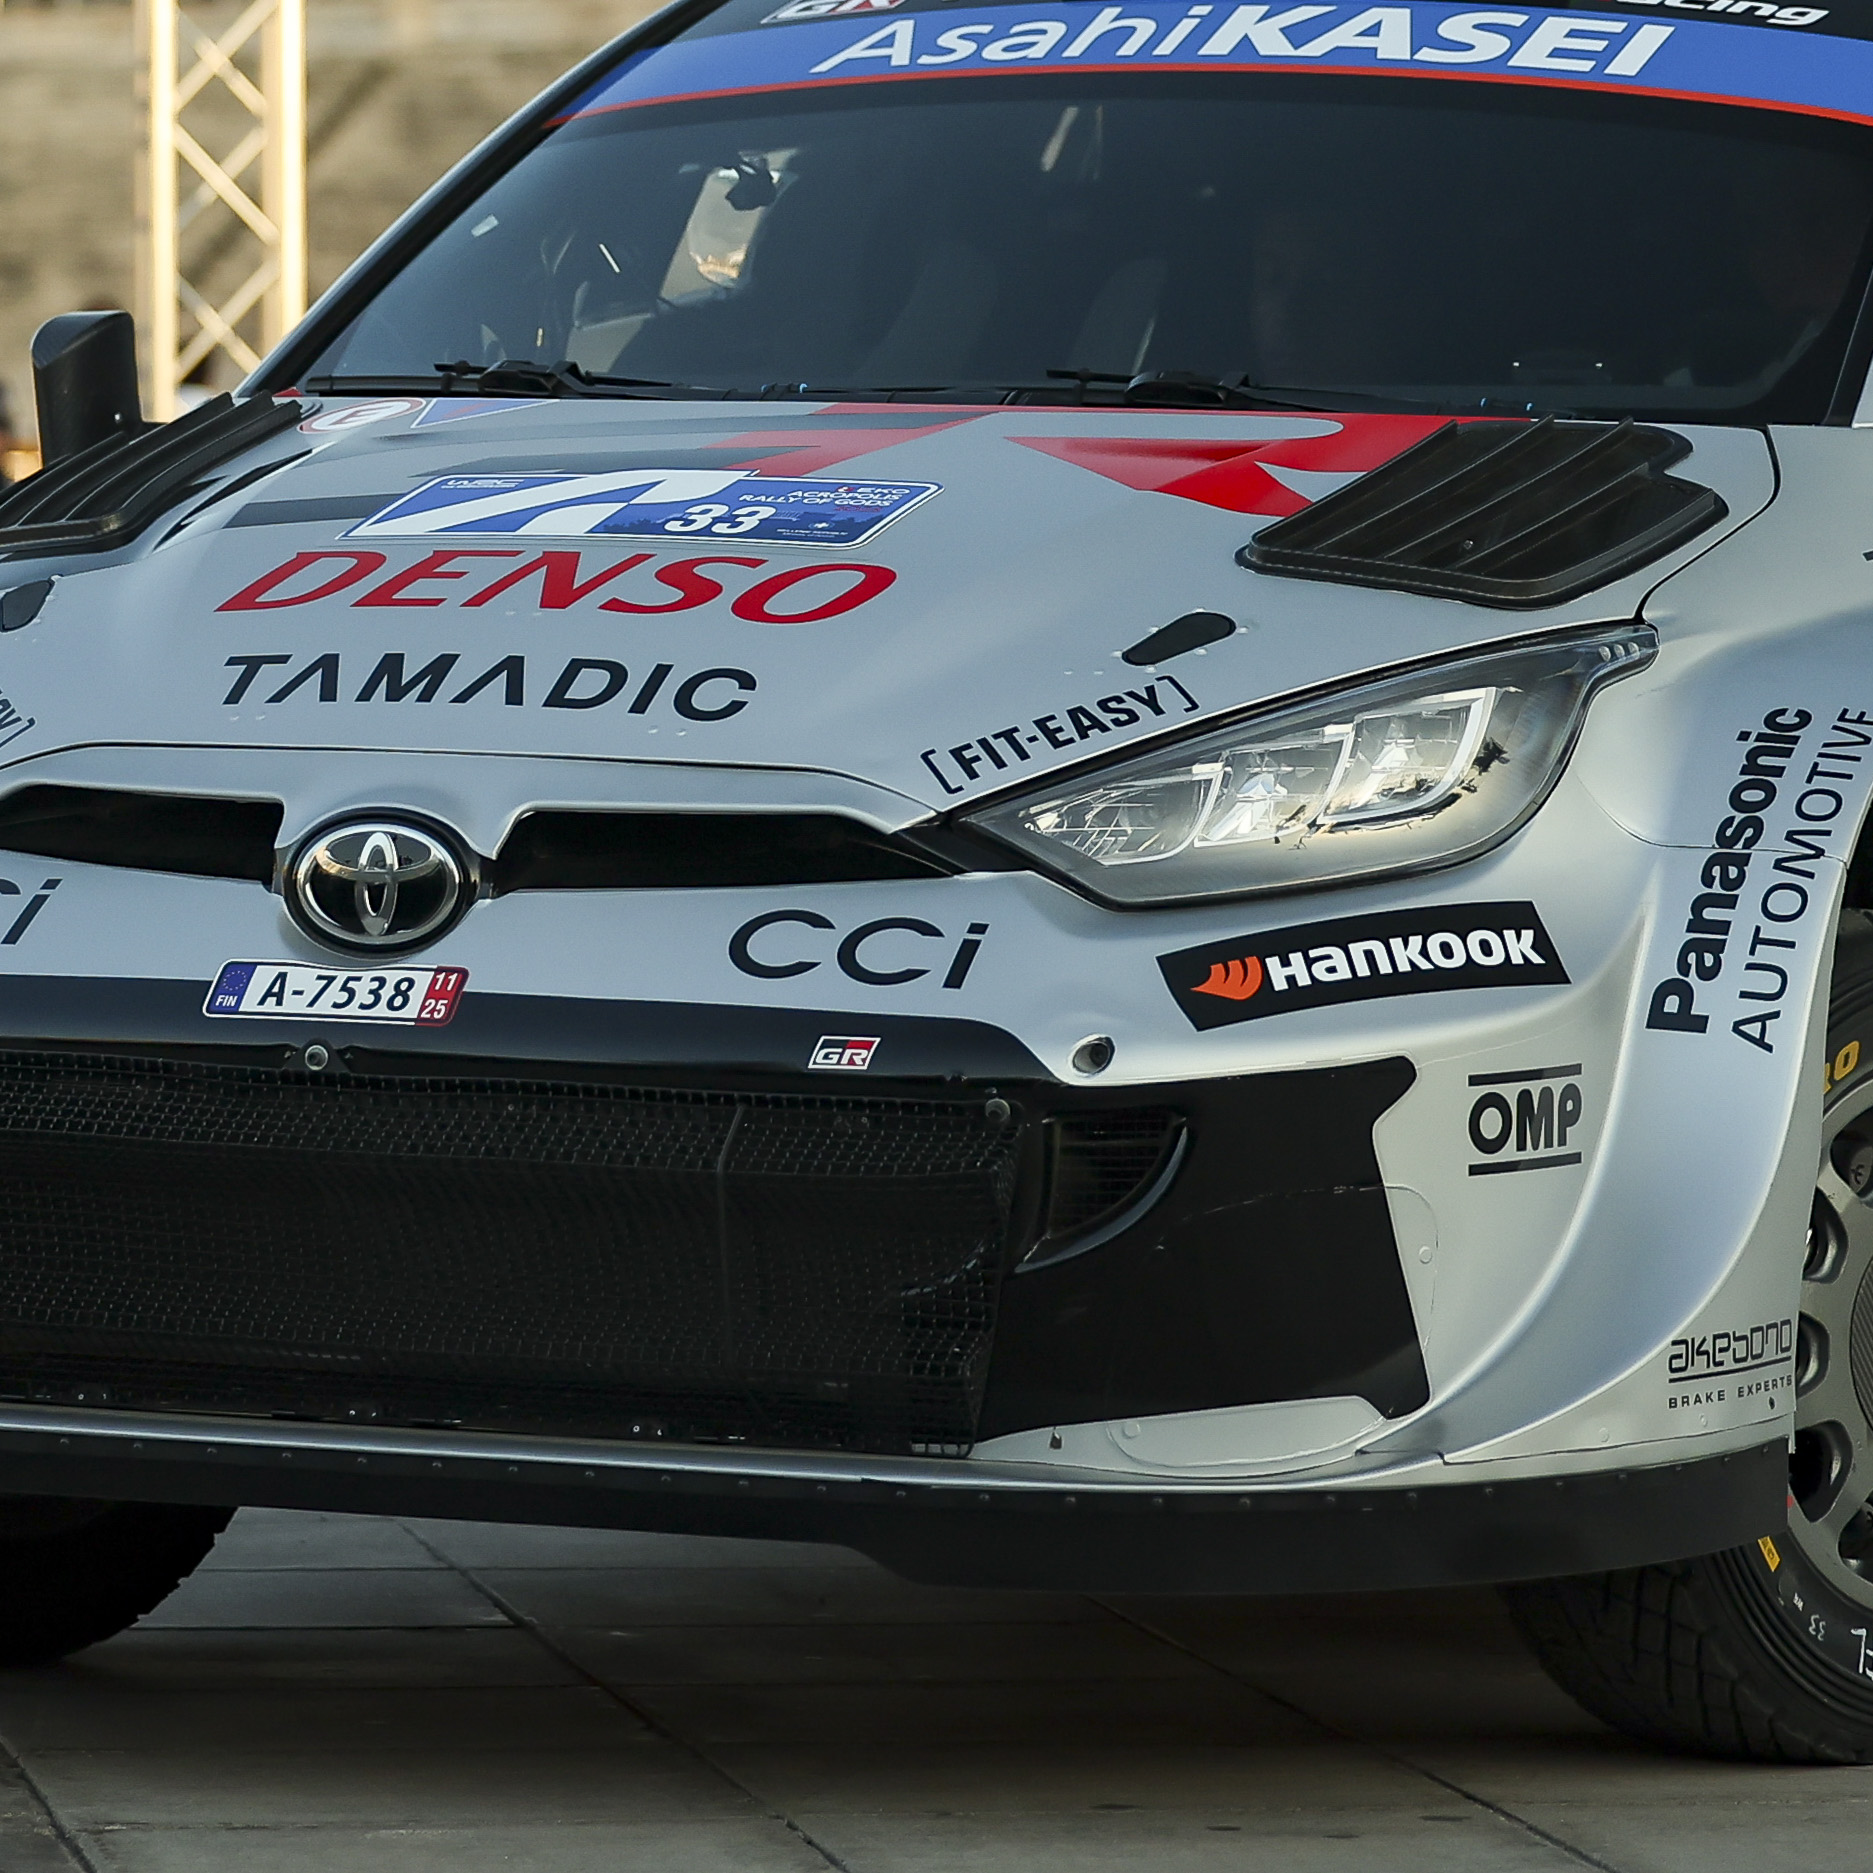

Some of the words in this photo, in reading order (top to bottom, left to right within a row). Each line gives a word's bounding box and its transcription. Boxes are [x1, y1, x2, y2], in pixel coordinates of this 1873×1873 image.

[739, 494, 800, 505] RALLY
[802, 497, 831, 505] OF
[834, 498, 894, 507] GODS
[787, 490, 903, 501] ACROPOLIS
[663, 504, 777, 535] 33
[214, 550, 897, 625] DENSO
[222, 653, 758, 722] TAMADIC
[1645, 707, 1812, 1035] Panasonic
[256, 971, 416, 1012] A-7538
[436, 972, 458, 992] 11
[215, 994, 239, 1008] FIN
[421, 999, 449, 1019] 25
[814, 1047, 870, 1067] GR
[1468, 1078, 1583, 1156] OMP
[1668, 1389, 1726, 1409] BRAKE
[1738, 1375, 1792, 1398] EXPERTS
[1808, 1614, 1826, 1641] 33
